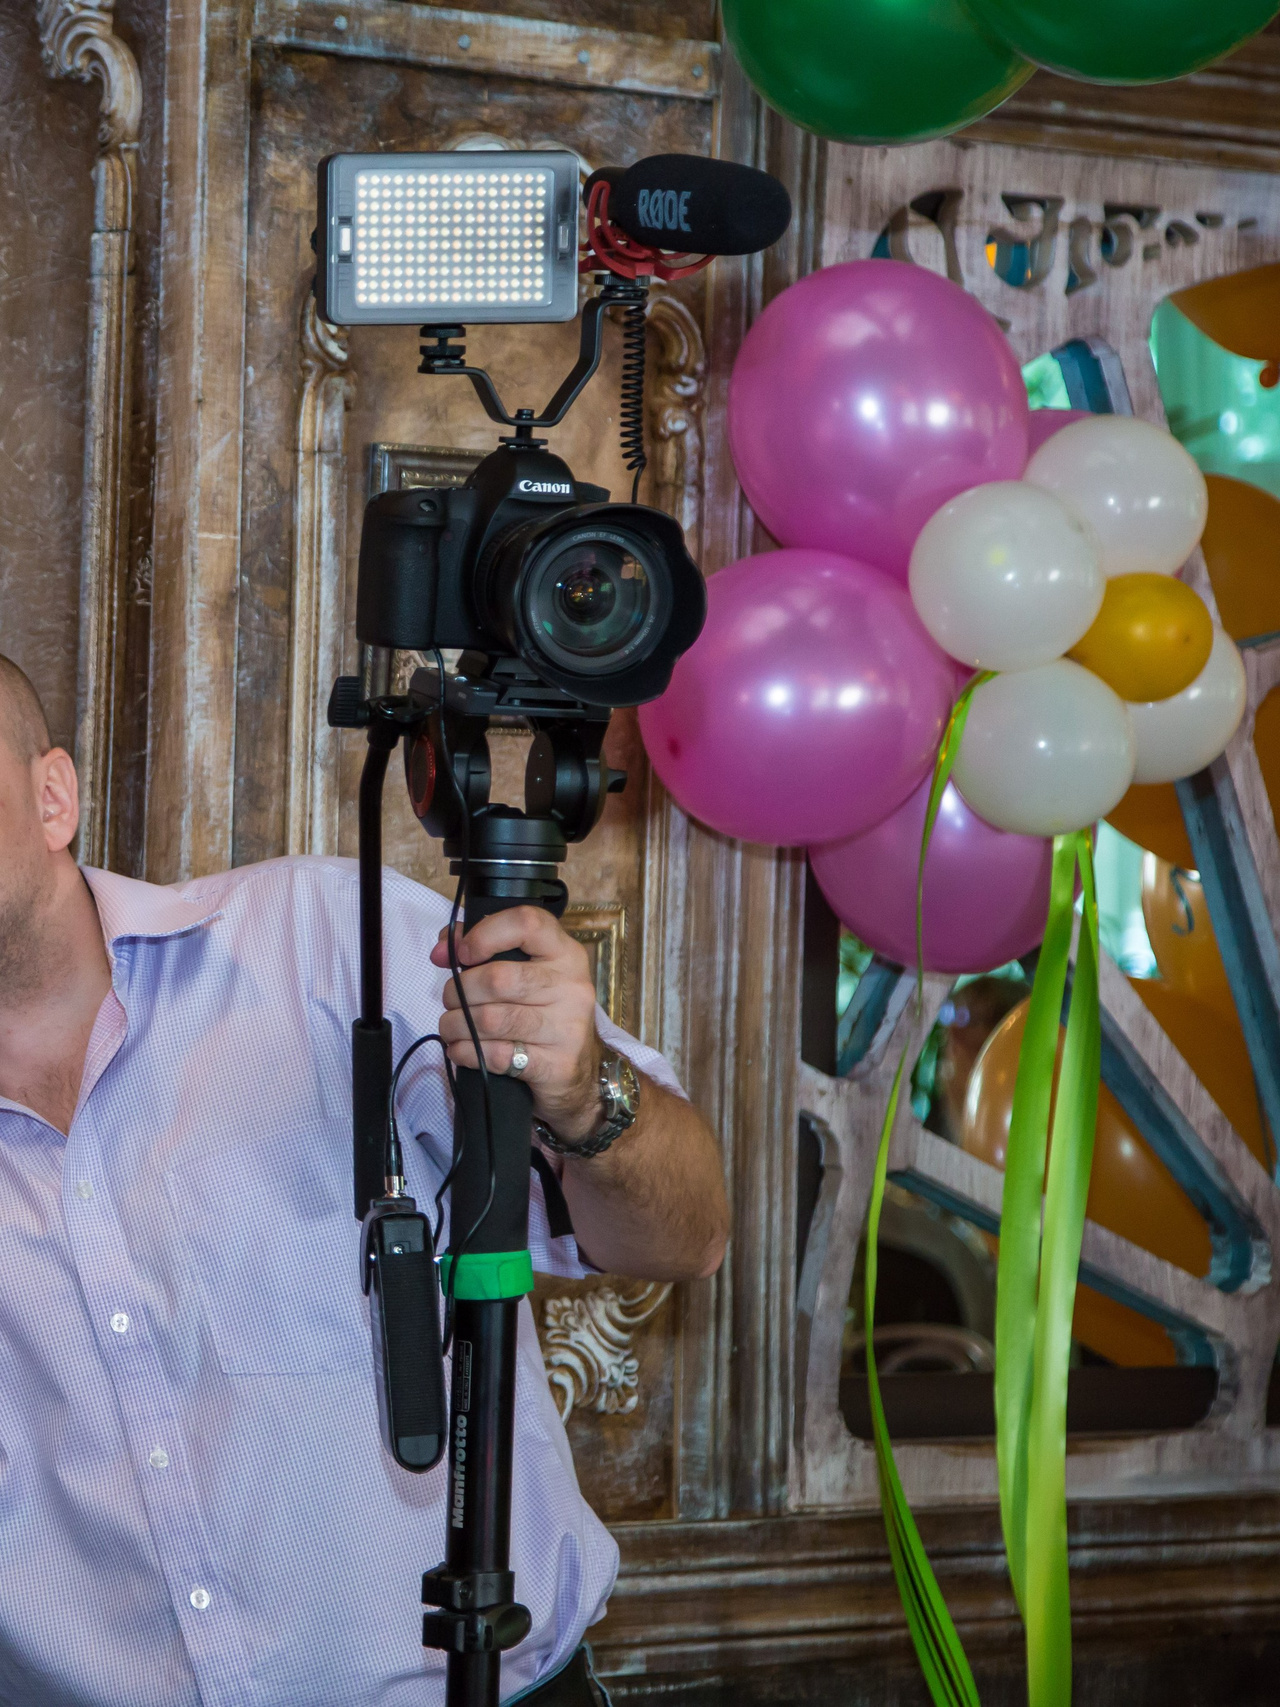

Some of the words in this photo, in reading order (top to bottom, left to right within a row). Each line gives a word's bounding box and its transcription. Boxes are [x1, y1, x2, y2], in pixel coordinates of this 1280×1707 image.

[519, 479, 571, 494] Canon
[572, 531, 597, 541] CANON
[452, 1414, 467, 1529] Manfrotto
